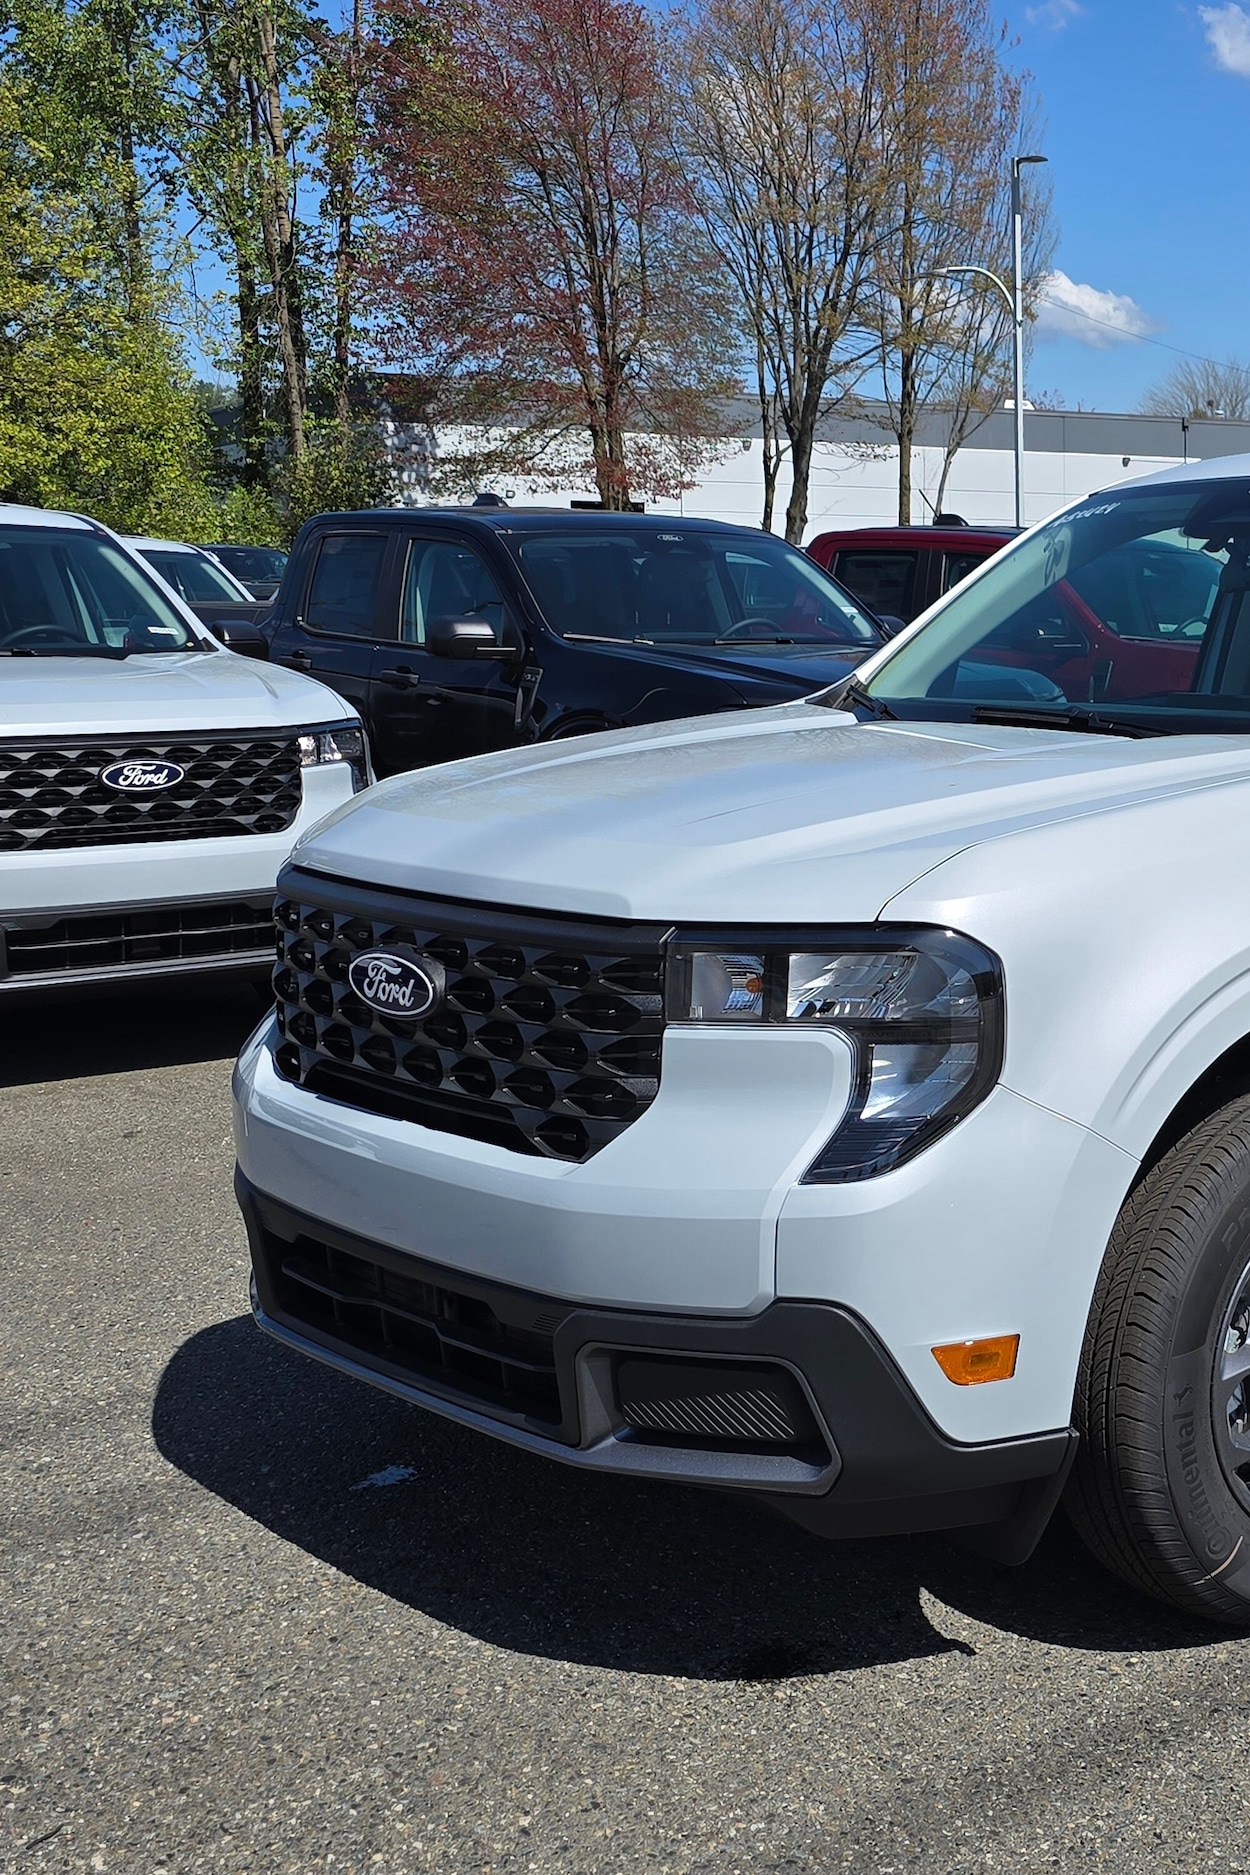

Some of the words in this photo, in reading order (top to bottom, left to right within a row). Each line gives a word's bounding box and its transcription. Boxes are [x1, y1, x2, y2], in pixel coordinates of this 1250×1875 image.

[118, 764, 168, 786] Ford
[363, 960, 415, 1007] Ford
[1172, 1411, 1231, 1560] Continental
